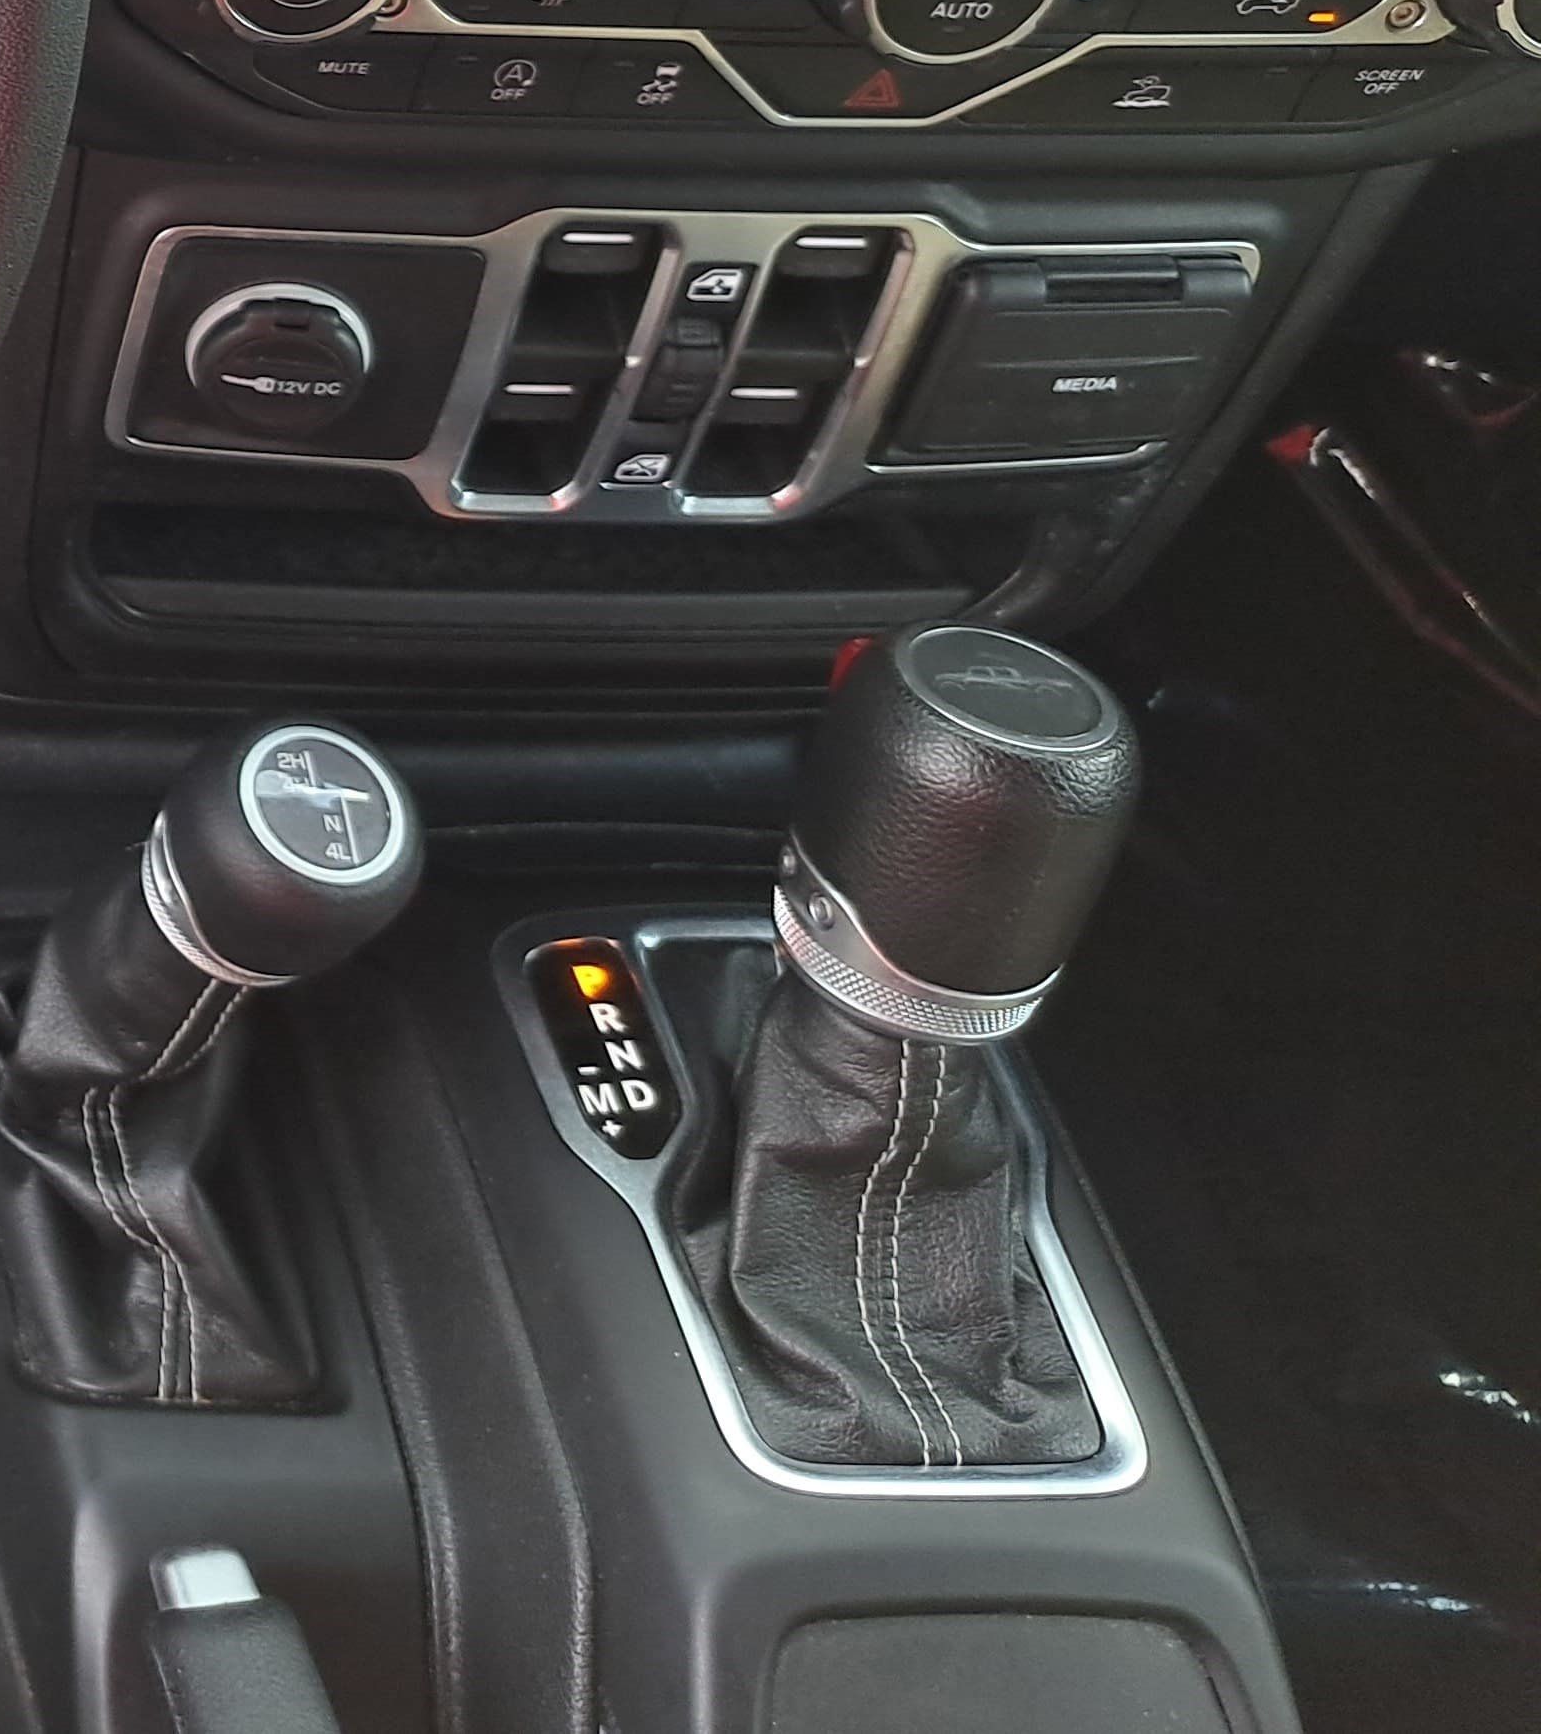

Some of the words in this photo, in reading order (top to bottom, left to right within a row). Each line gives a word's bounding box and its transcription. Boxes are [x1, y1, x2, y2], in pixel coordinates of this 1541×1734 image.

[930, 2, 994, 19] AUTO
[318, 61, 370, 75] MUTE
[1354, 69, 1425, 82] SCREEN
[490, 88, 526, 100] OFF
[1363, 82, 1400, 95] OFF
[636, 92, 673, 105] OFF
[277, 380, 311, 394] 12V
[314, 382, 341, 395] DC
[1052, 376, 1118, 392] MEDIA
[276, 751, 307, 770] 2H
[323, 814, 342, 833] N
[325, 842, 352, 862] 4L
[588, 1002, 626, 1033] R
[604, 1039, 643, 1072] N
[578, 1082, 620, 1115] M
[621, 1078, 655, 1112] D
